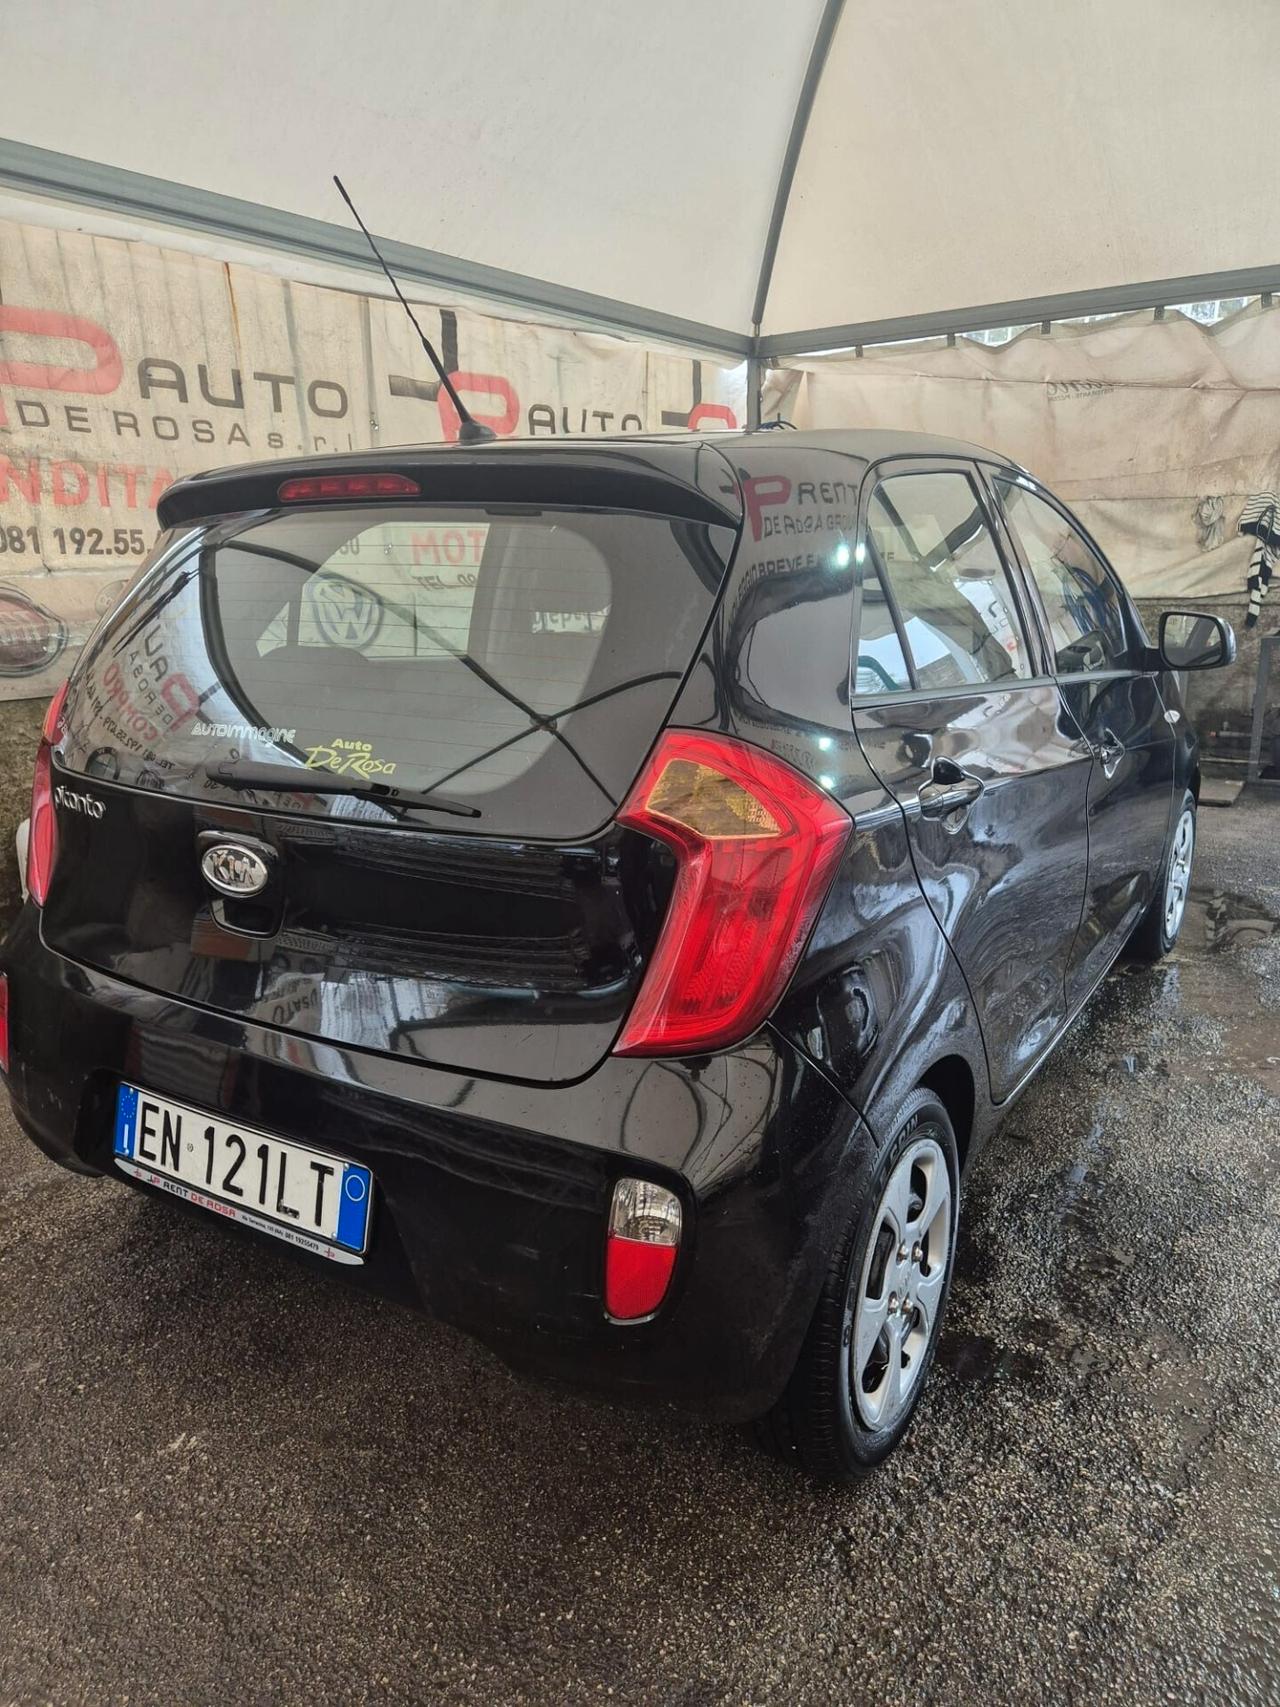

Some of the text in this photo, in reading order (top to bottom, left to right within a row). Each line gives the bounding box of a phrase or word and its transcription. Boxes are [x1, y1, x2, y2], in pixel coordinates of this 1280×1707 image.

[138, 357, 348, 419] AUTO
[331, 737, 373, 752] Auto
[206, 847, 260, 889] KIA
[138, 1100, 182, 1172] EN
[163, 1180, 188, 1197] RENT
